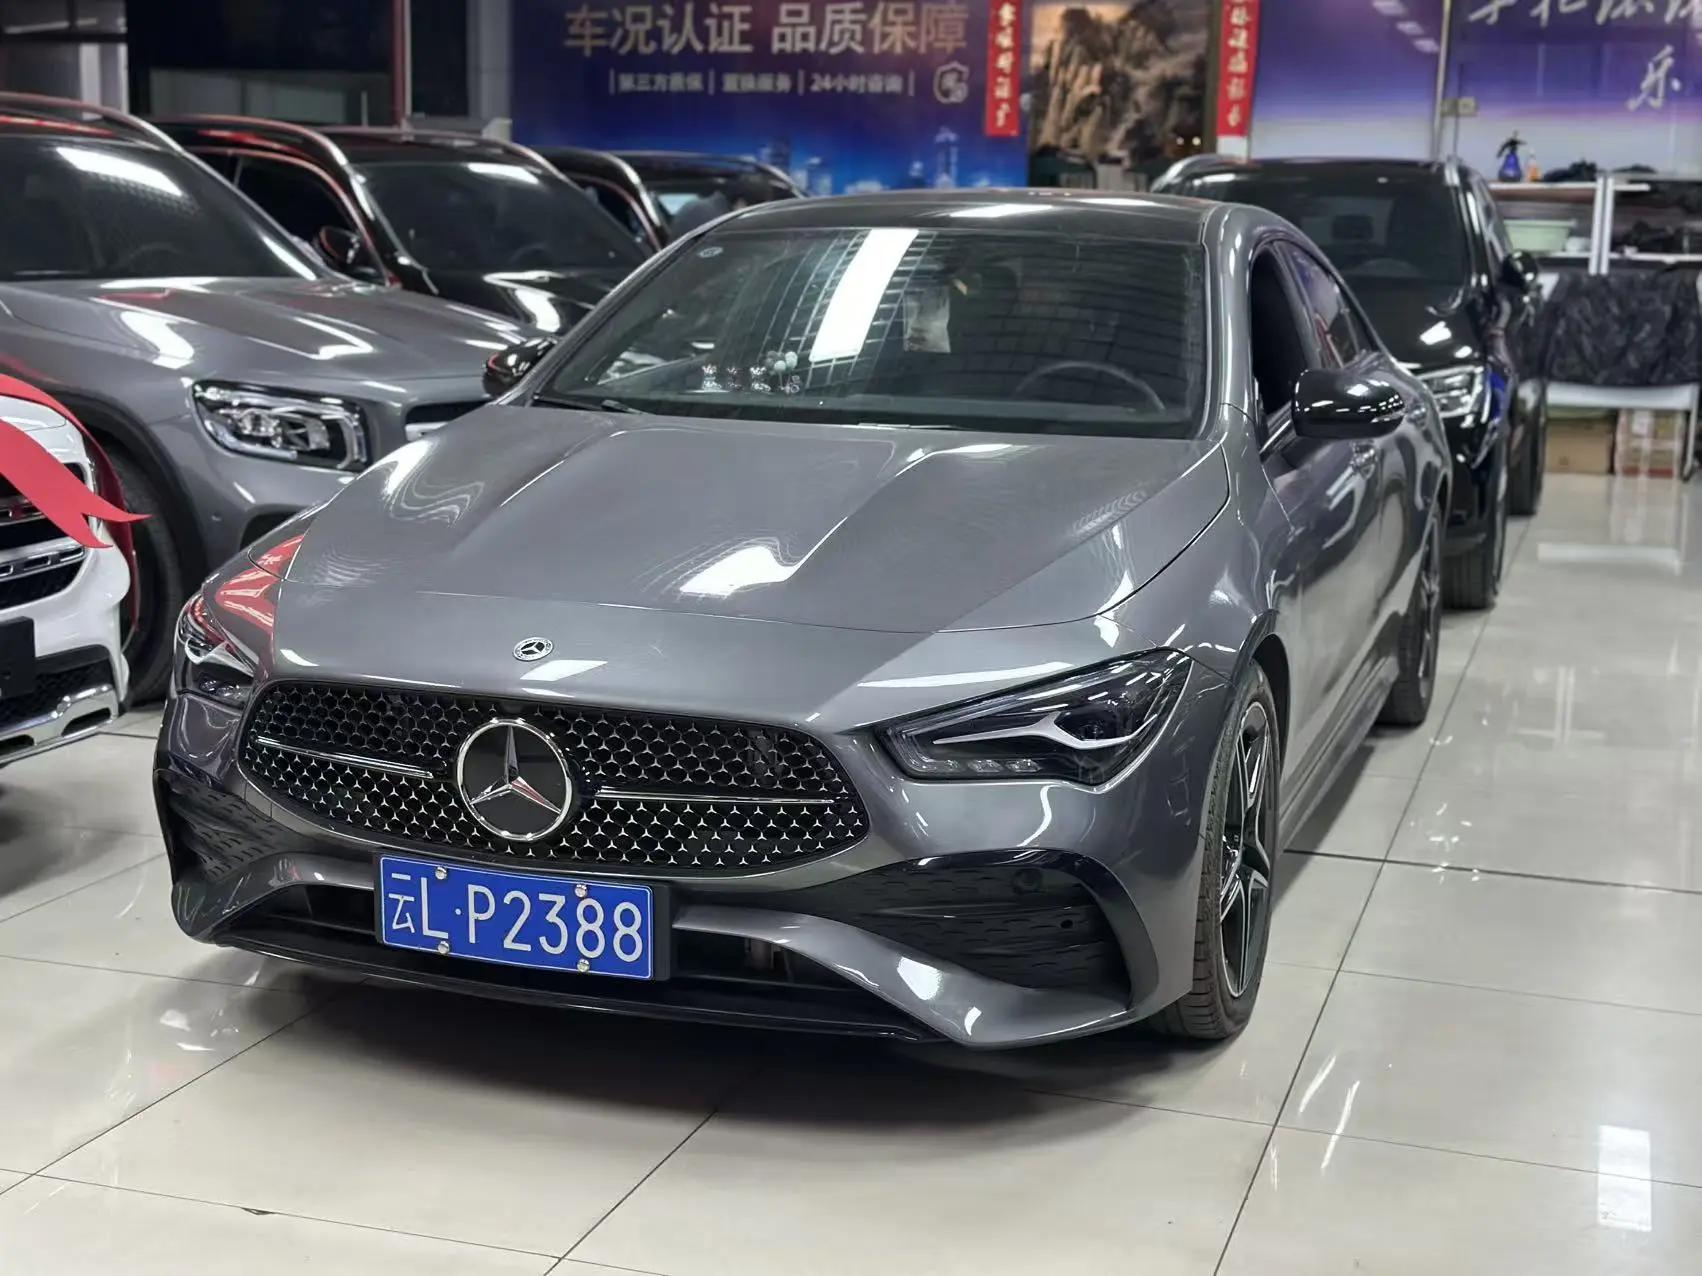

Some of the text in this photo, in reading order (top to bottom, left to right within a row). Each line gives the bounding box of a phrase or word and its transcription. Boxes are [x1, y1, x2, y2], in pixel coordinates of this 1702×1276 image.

[563, 0, 970, 57] 车况认证 品质保障
